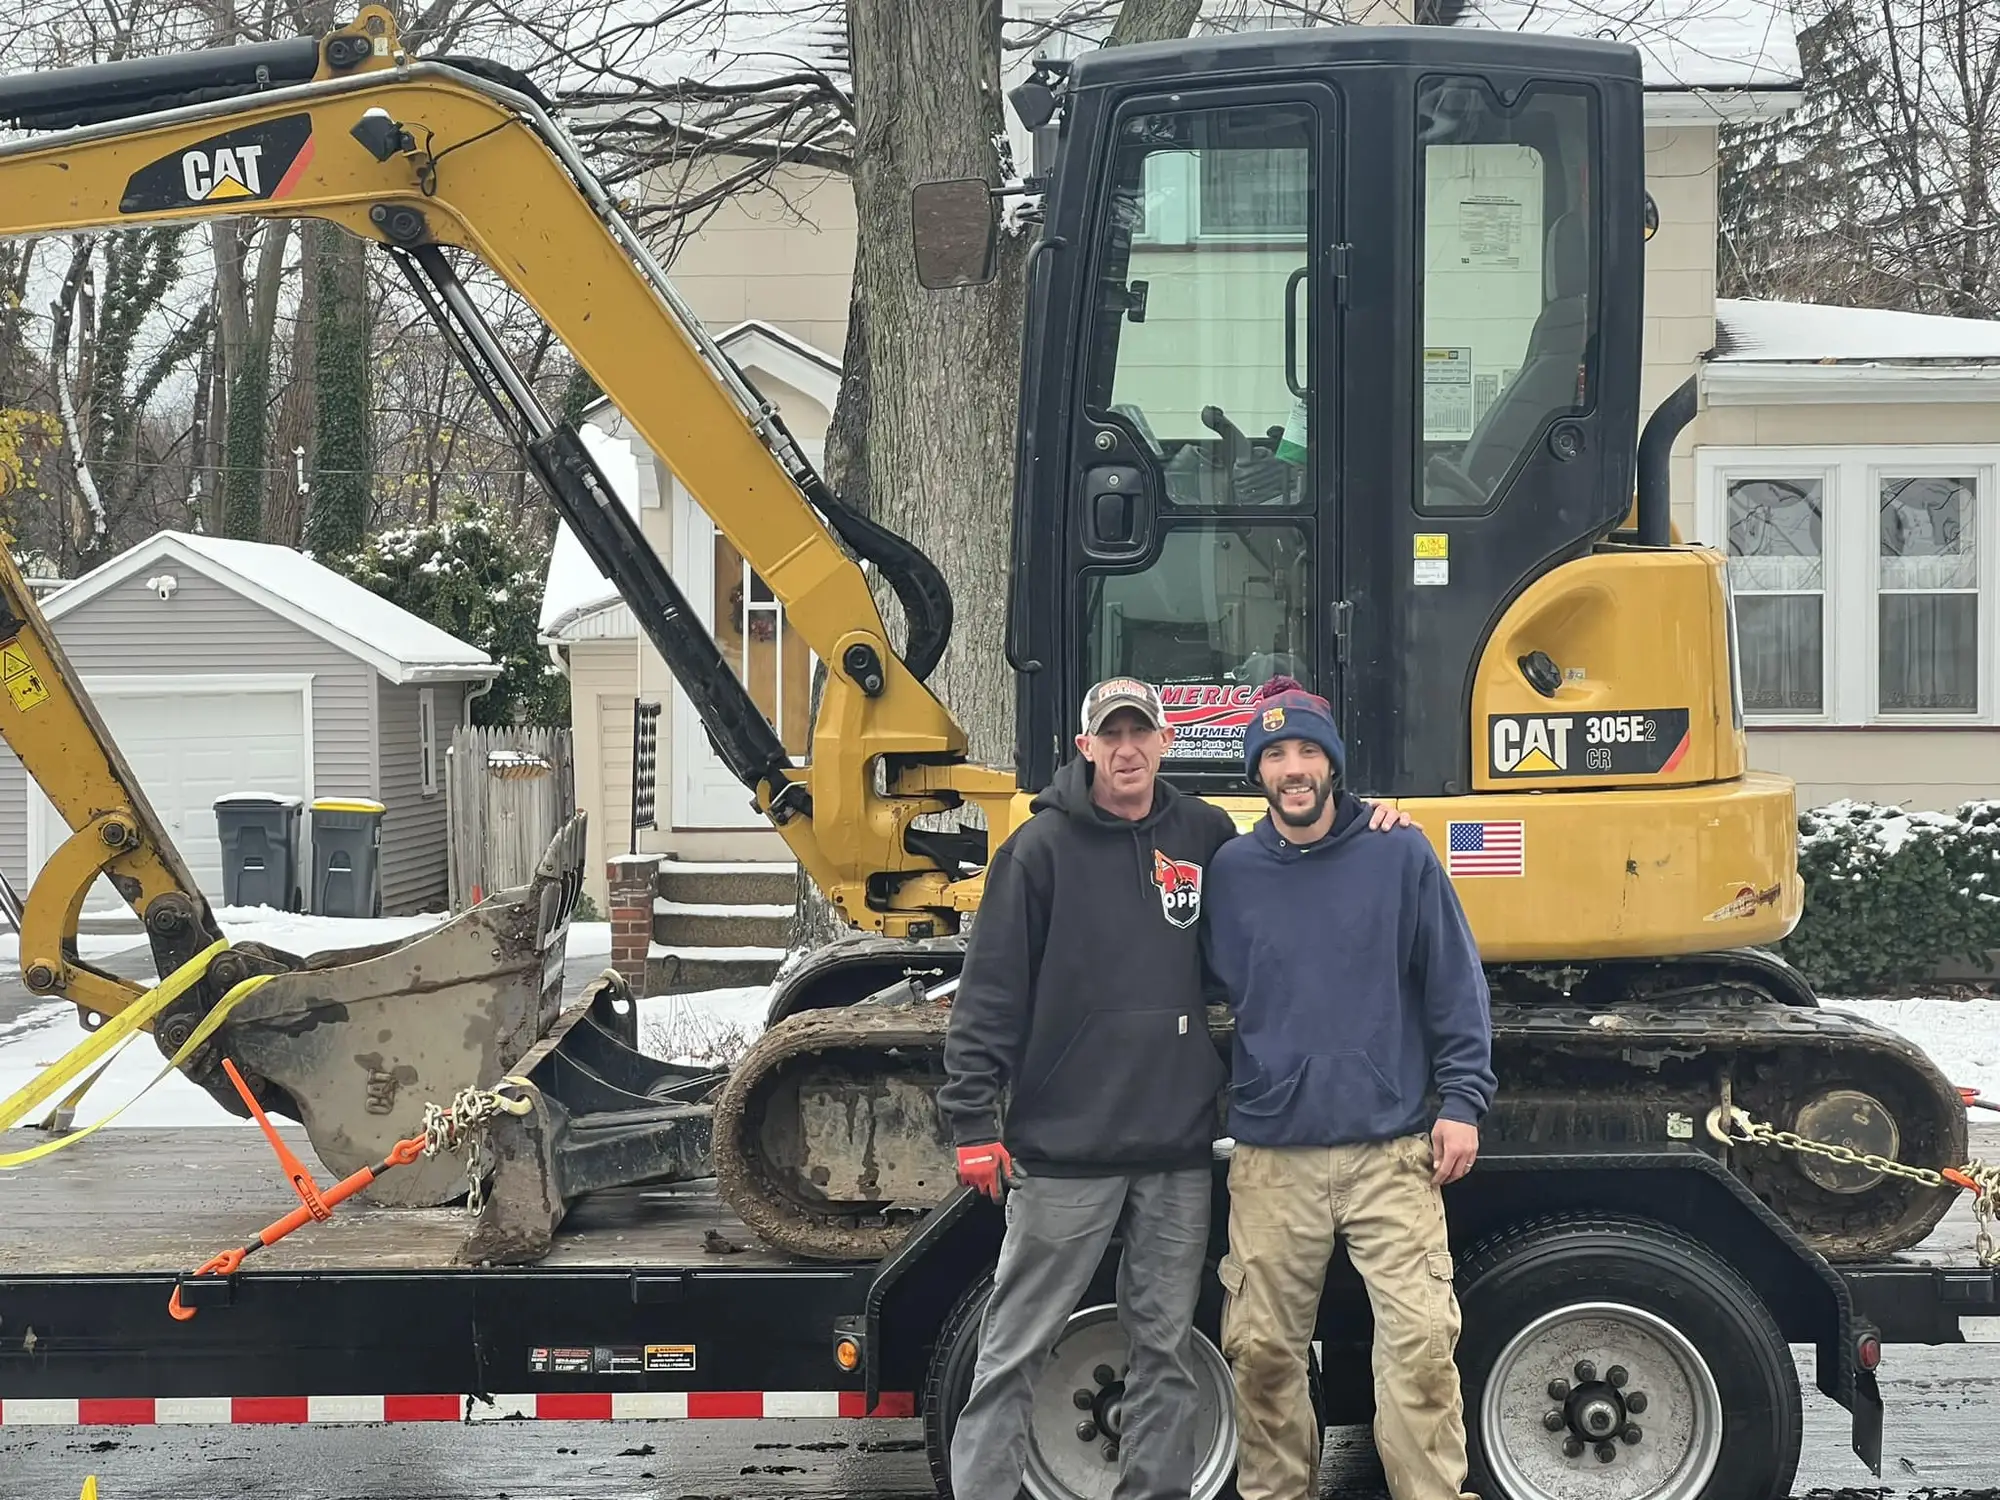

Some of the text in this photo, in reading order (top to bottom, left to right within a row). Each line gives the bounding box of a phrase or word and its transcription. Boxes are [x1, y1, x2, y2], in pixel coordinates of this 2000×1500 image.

[182, 145, 263, 201] CAT
[1158, 685, 1263, 706] MERICA
[1175, 726, 1248, 738] QUIPMENT
[1494, 717, 1574, 772] CAT
[1586, 748, 1612, 770] CR
[1164, 892, 1200, 909] OPP
[366, 1069, 396, 1115] CAT
